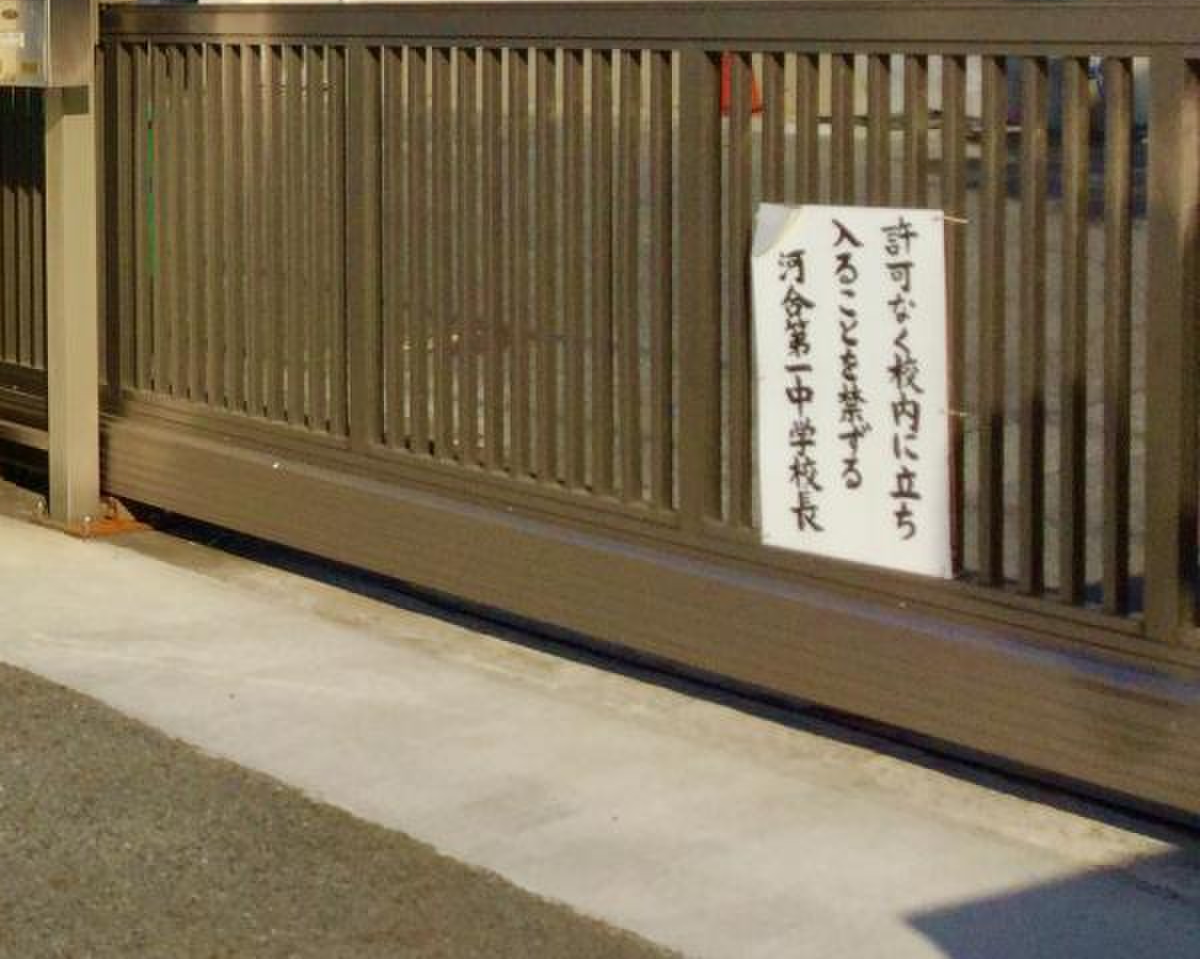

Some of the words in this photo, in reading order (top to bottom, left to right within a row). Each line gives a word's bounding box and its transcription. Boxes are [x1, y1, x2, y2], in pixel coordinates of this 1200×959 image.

[777, 248, 825, 533] 河合第一中学校長
[831, 218, 872, 490] 入ることを禁ずる
[881, 216, 925, 540] 許可なく校内に立ち
